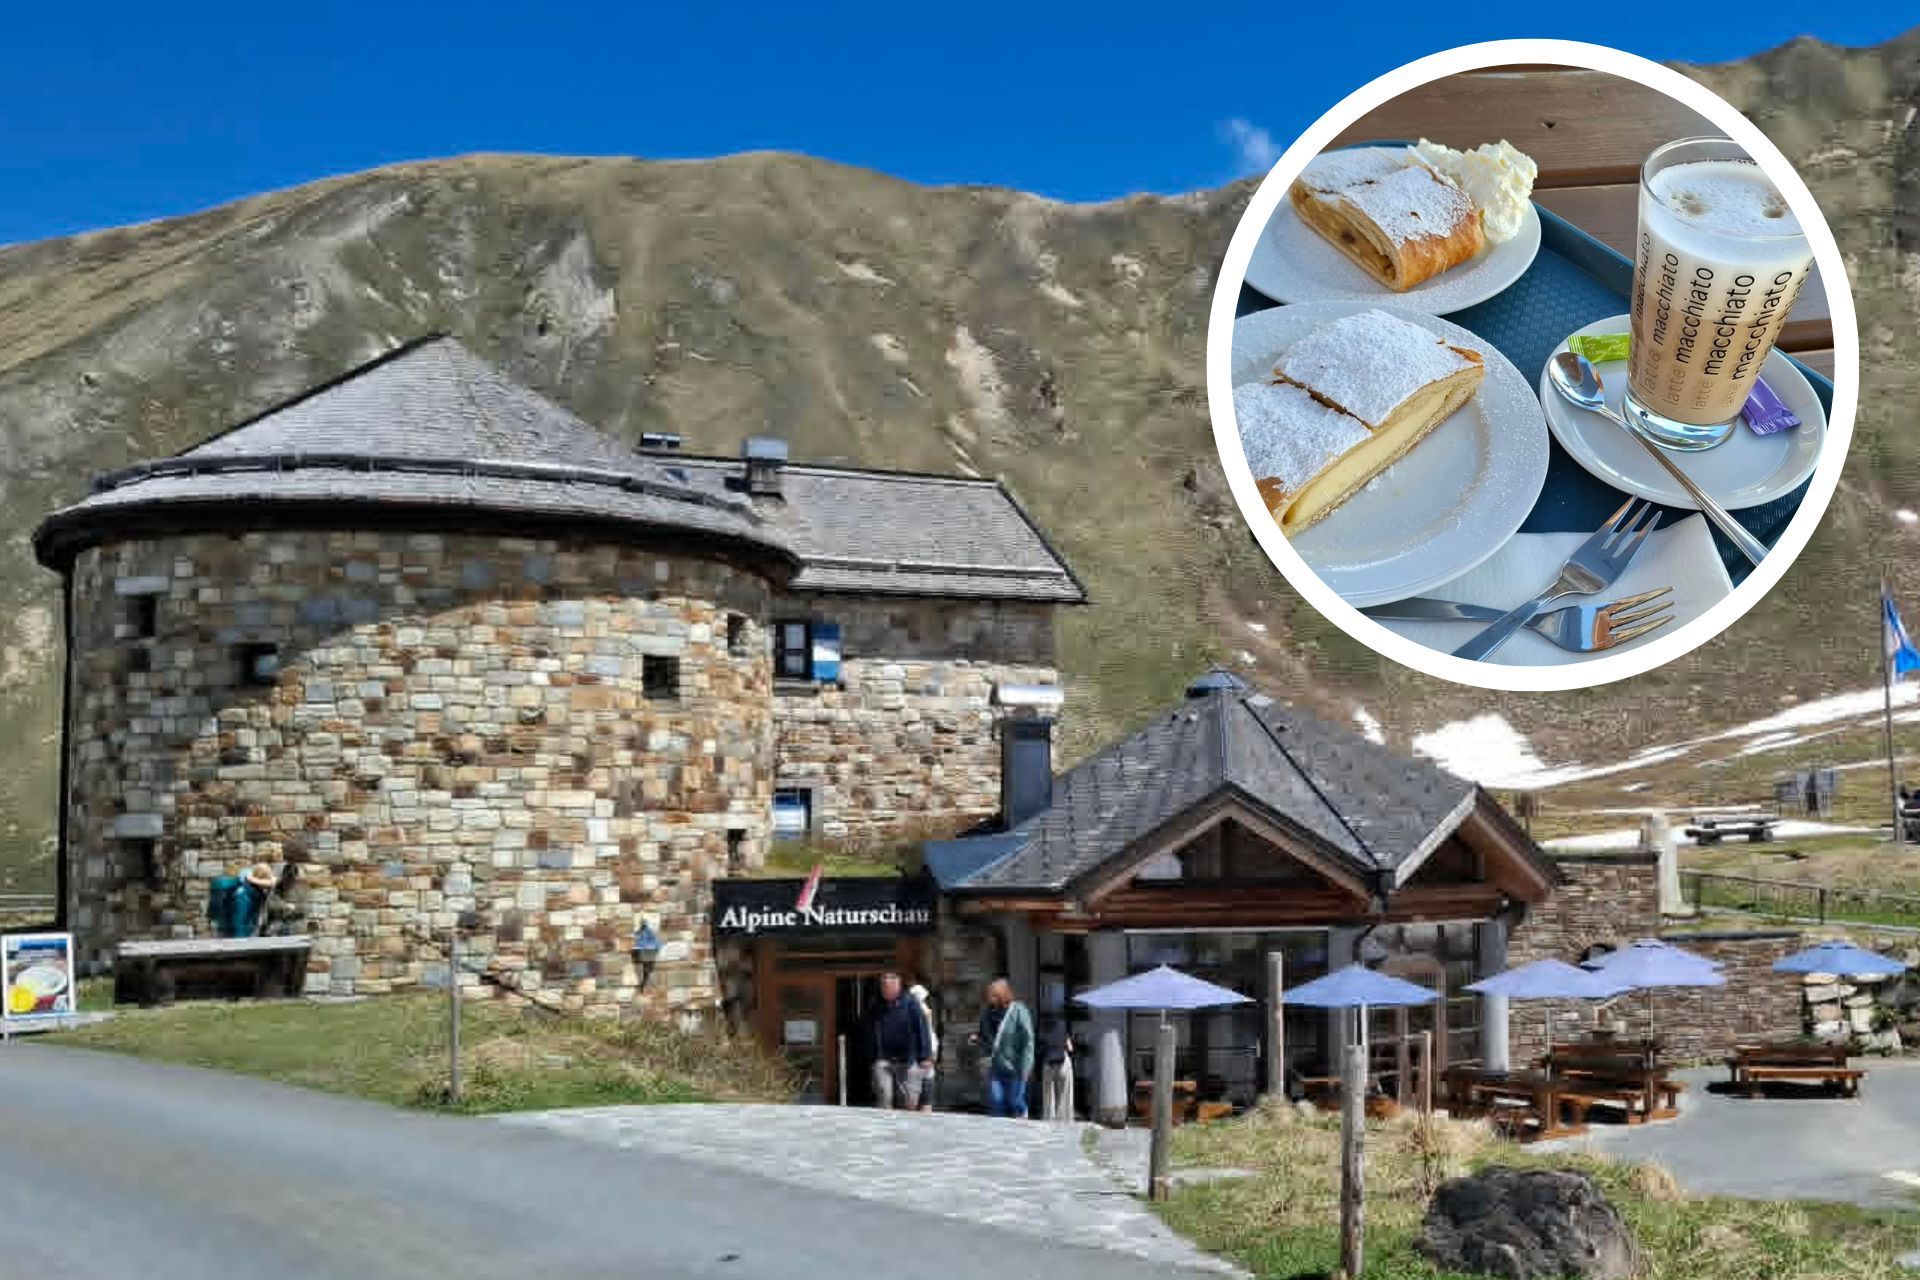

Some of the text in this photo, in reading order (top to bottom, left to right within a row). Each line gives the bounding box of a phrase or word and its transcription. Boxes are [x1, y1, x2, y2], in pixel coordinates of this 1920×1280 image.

[1635, 232, 1651, 320] macchiato
[1640, 253, 1679, 395] latte macchiato
[1662, 267, 1714, 406] latte macchiato
[1732, 271, 1793, 381] macchiato
[1690, 274, 1755, 411] latte macchiato
[718, 903, 931, 933] Alpine Naturschau
